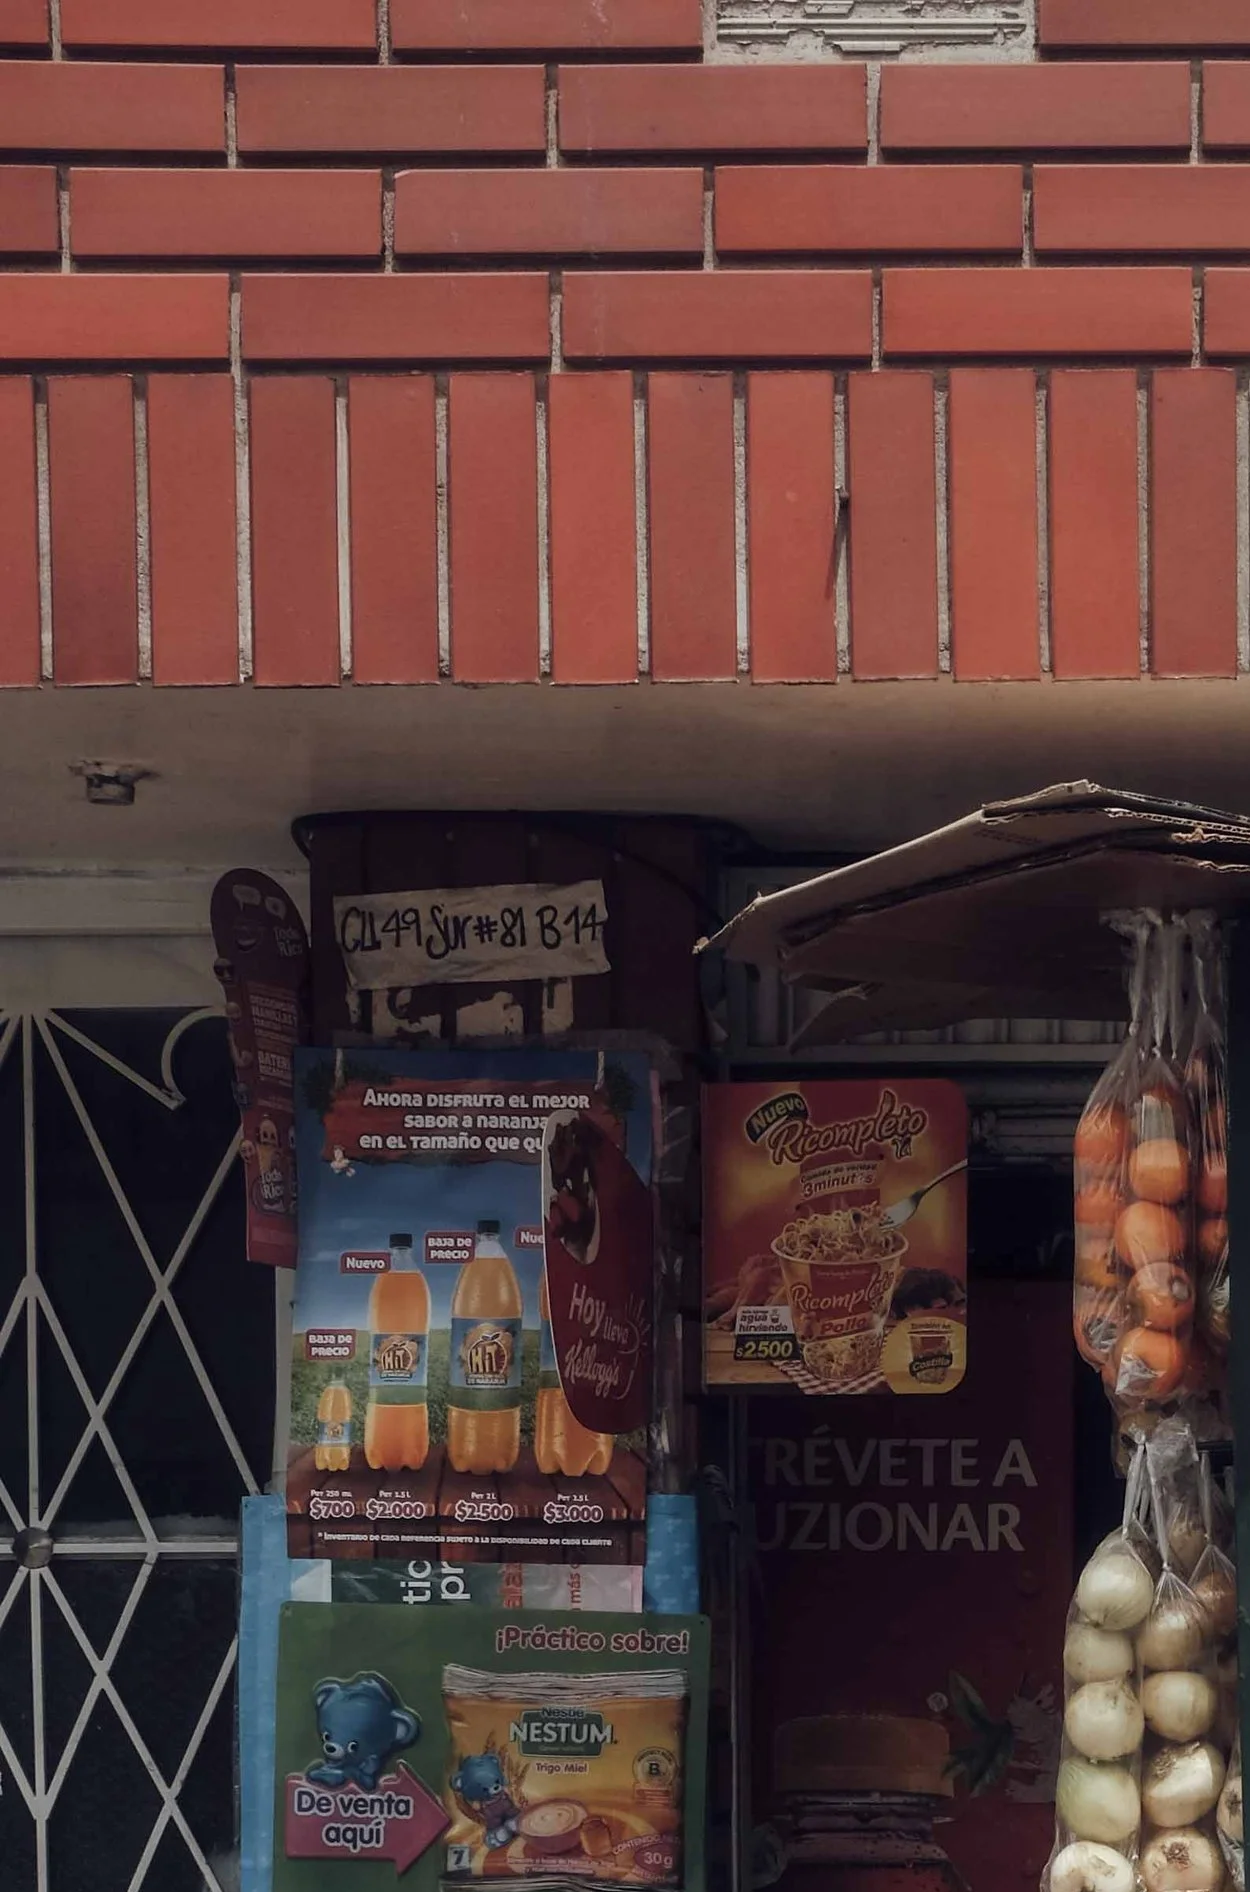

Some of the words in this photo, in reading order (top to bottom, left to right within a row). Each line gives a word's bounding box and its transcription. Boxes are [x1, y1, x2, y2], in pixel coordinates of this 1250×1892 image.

[751, 1095, 805, 1134] Nuevo
[769, 1090, 927, 1165] Ricompleto
[346, 1256, 385, 1269] Nuevo
[568, 1281, 606, 1337] Hoy
[991, 1438, 1039, 1488] A
[309, 1497, 355, 1520] $700
[494, 1625, 604, 1654] ¡Práctico
[610, 1626, 690, 1654] sobre!
[508, 1722, 614, 1746] NESTUM
[535, 1762, 561, 1775] Trigo
[563, 1762, 588, 1774] Miel
[296, 1789, 335, 1816] De
[337, 1791, 413, 1819] venta
[321, 1819, 386, 1853] aquí
